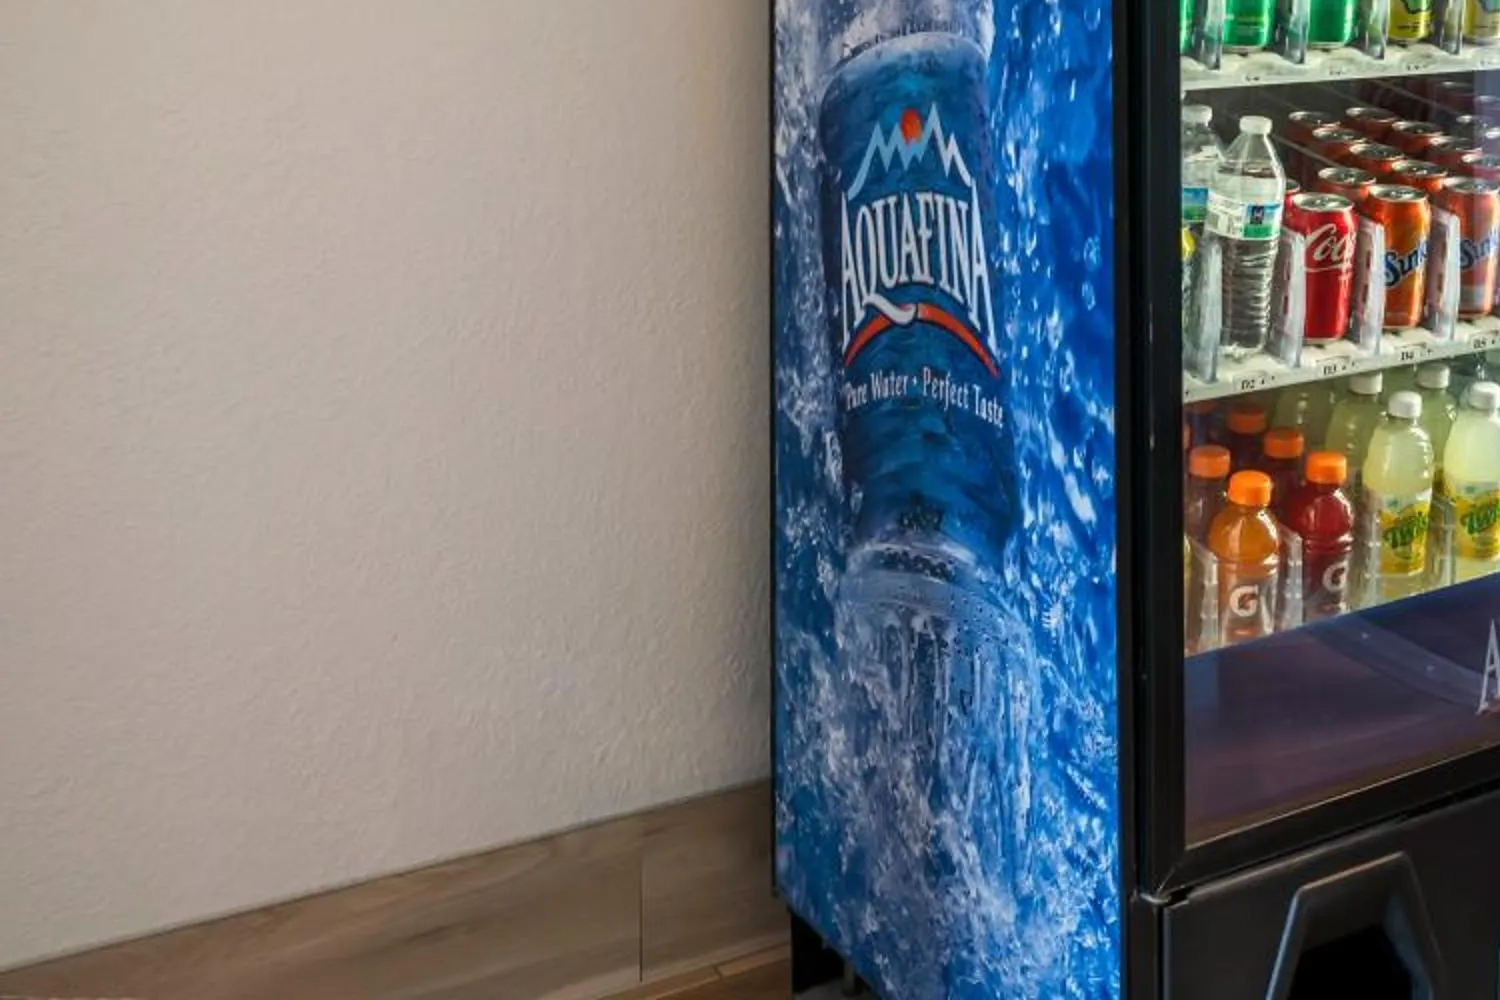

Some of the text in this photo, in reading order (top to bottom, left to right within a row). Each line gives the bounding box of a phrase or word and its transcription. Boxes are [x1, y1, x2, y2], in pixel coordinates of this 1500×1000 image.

[841, 178, 1001, 360] AQUAFINA
[870, 371, 909, 401] Water
[922, 366, 970, 410] Perfect
[972, 386, 1005, 428] Taste
[1229, 585, 1259, 617] G
